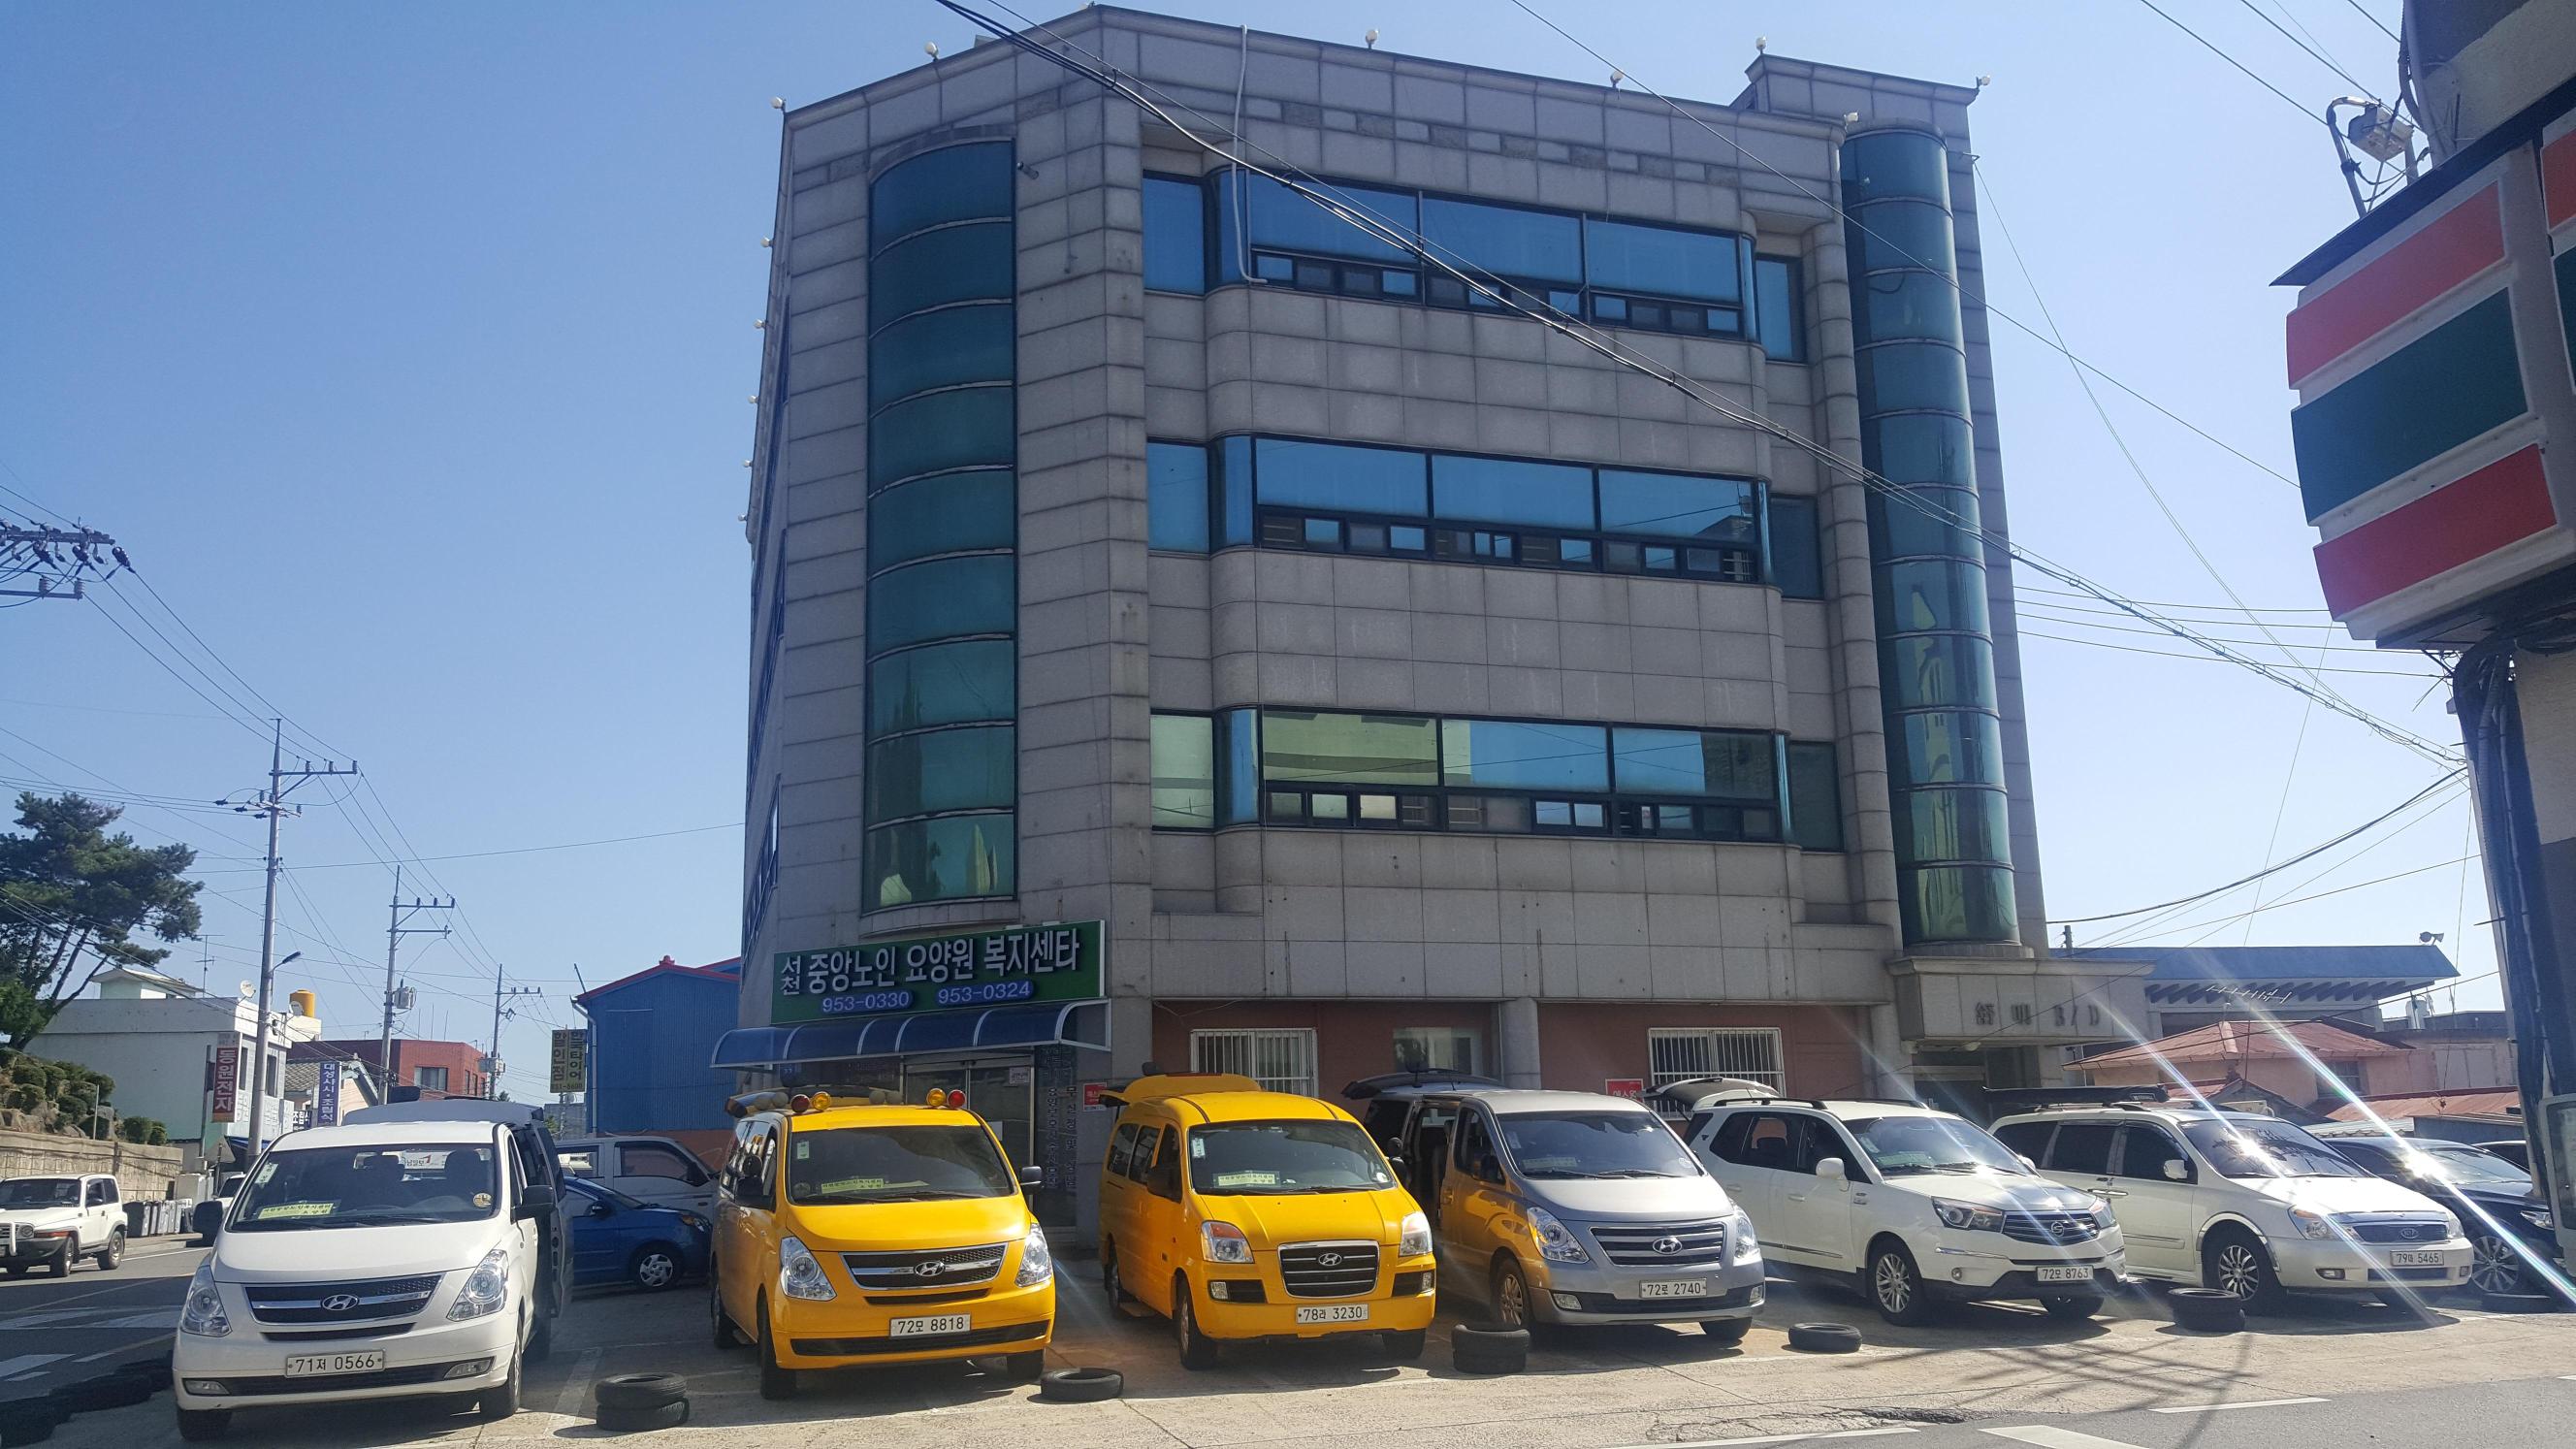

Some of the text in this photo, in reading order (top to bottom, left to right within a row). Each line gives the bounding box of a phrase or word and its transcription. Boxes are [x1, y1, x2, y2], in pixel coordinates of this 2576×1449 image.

[782, 928, 1079, 995] 서천 중앙노인 요양원 복지센타
[822, 981, 1030, 1012] 953-0330 953-0324
[214, 1049, 237, 1111] 동원전자
[2417, 1252, 2439, 1263] 5465
[2066, 1268, 2088, 1278] 8763
[1648, 1282, 1700, 1296] 72로 2740
[1304, 1306, 1362, 1321] 78라 3230
[898, 1316, 964, 1334] 72모 8818
[295, 1354, 374, 1373] 71저 0566
